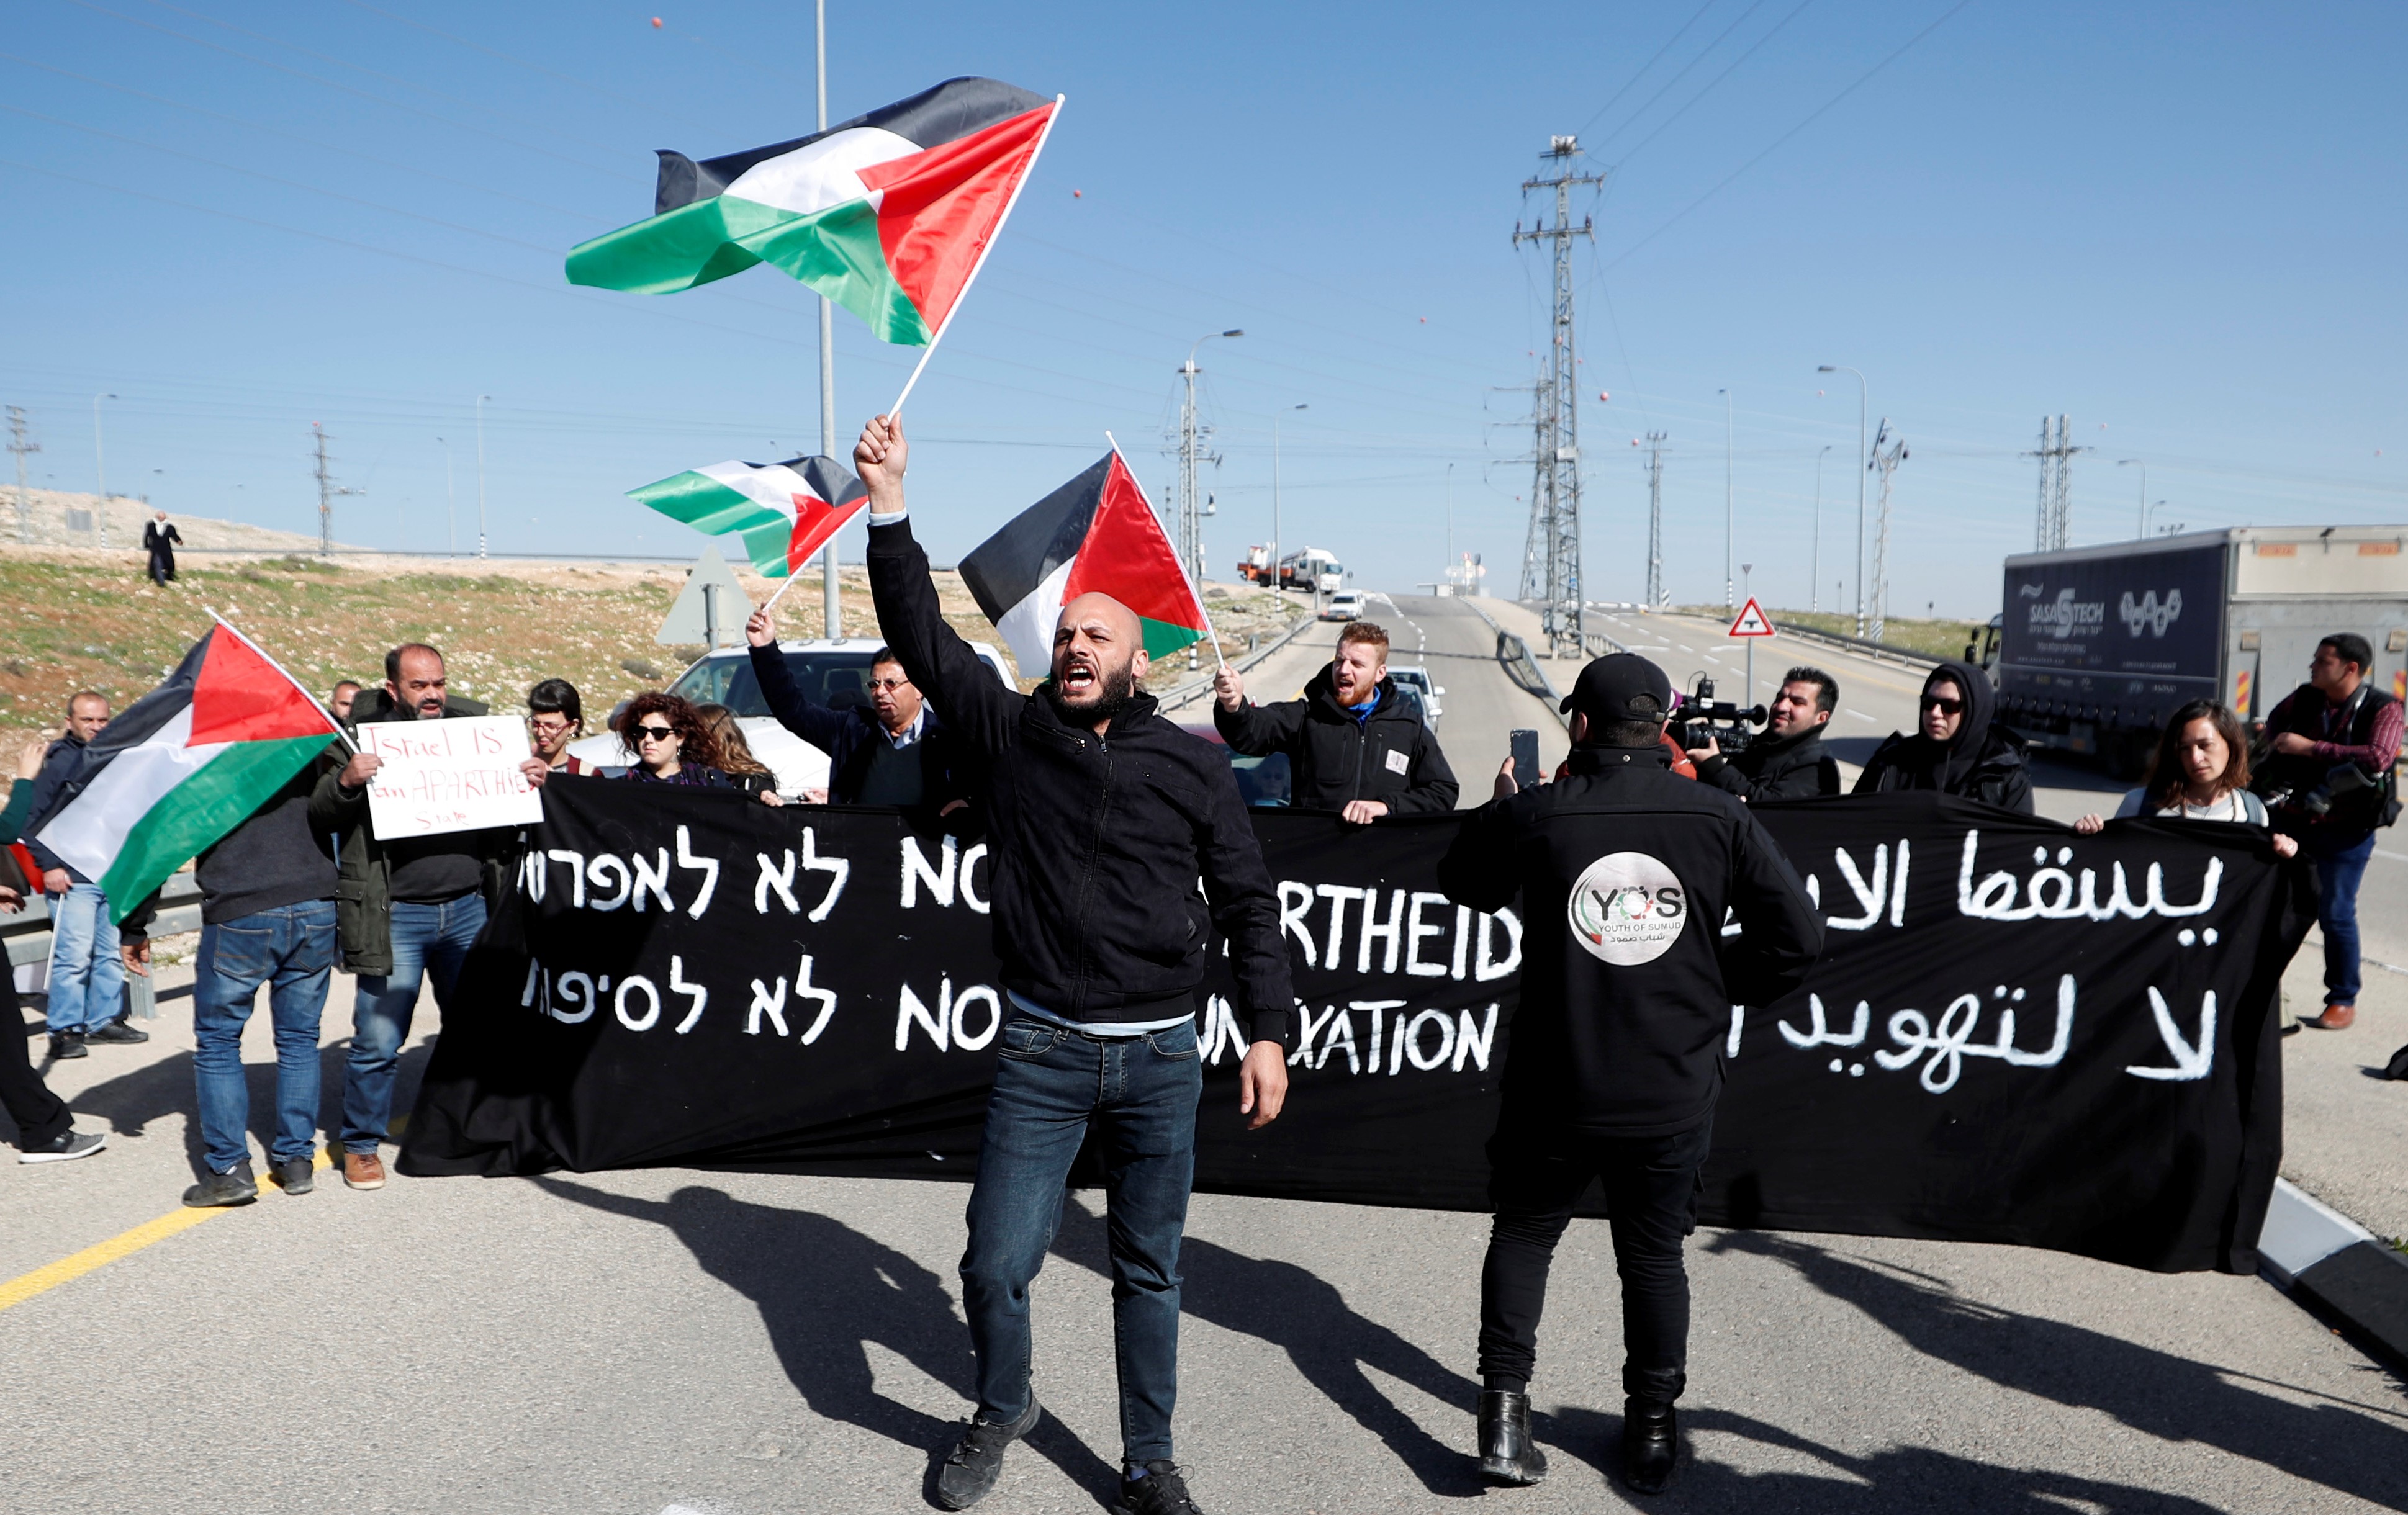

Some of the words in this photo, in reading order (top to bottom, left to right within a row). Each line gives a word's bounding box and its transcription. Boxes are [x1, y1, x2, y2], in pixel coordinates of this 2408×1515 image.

[364, 726, 452, 760] Israel
[473, 727, 502, 755] IS
[754, 826, 849, 923] לא
[1958, 829, 2224, 947] يسقط
[1599, 925, 1631, 933] YOUTH
[1648, 922, 1682, 930] SUMUD
[1610, 935, 1638, 943] صمود
[1639, 932, 1666, 942] شباب
[744, 954, 837, 1046] לא
[895, 977, 1002, 1053] NO
[1777, 973, 2077, 1094] لتهويد
[2125, 986, 2217, 1081] لا
